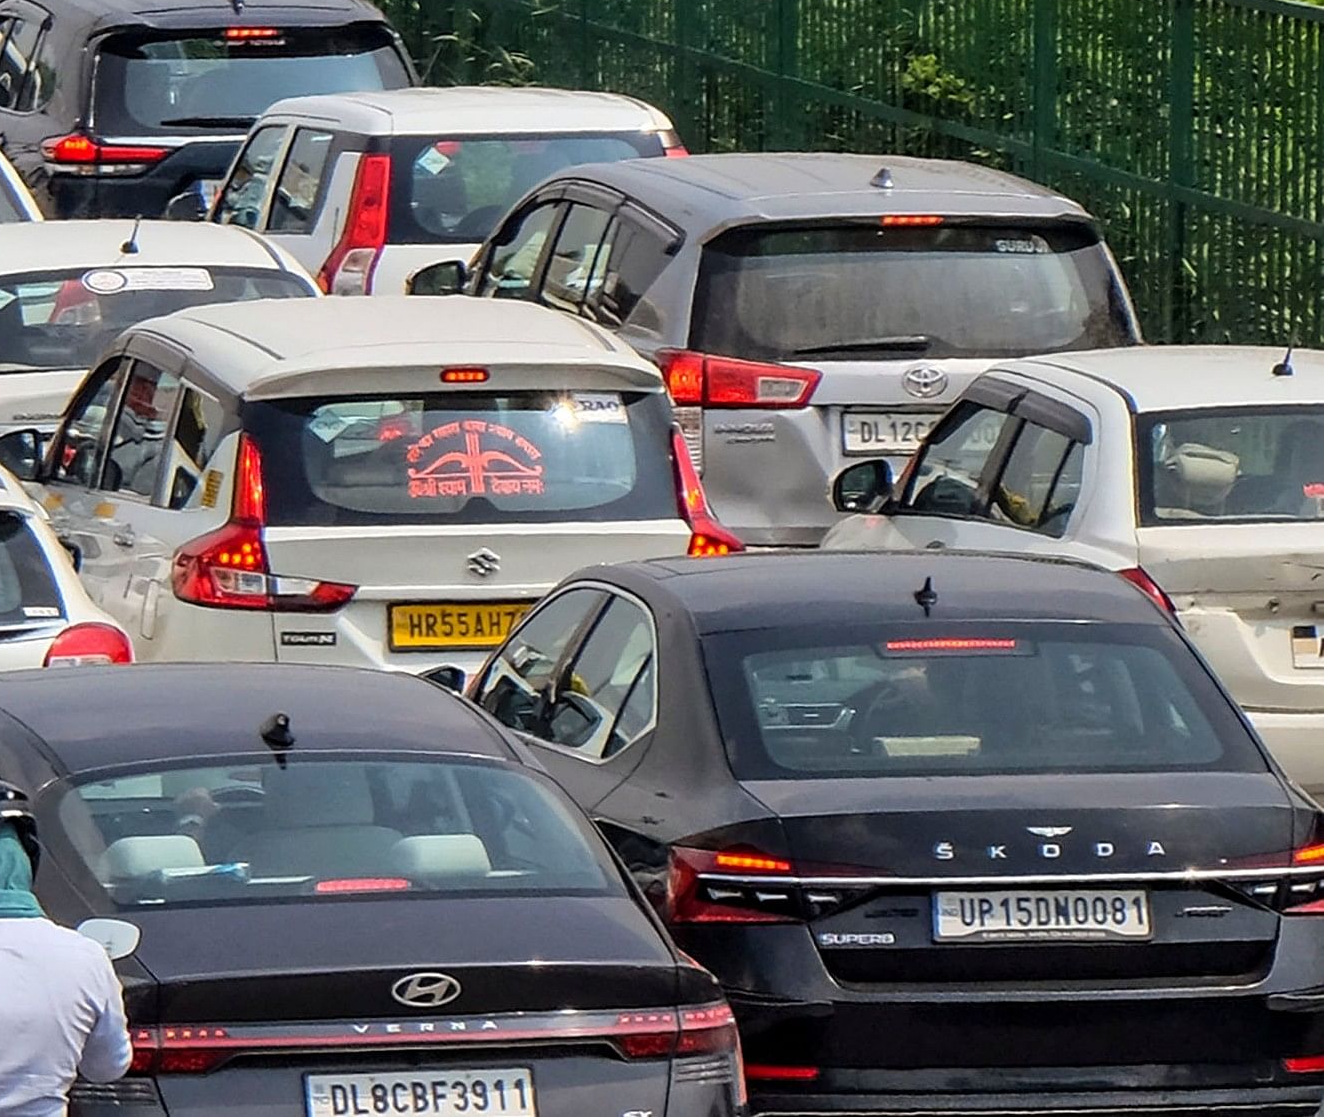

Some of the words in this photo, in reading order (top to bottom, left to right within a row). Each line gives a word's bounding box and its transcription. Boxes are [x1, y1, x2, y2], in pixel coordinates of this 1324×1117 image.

[408, 610, 526, 638] HR55AH7
[935, 839, 1167, 860] ŠKODA
[821, 932, 895, 945] SUPERB
[352, 1020, 498, 1033] VERNA
[330, 1078, 529, 1115] DL8CBF3911
